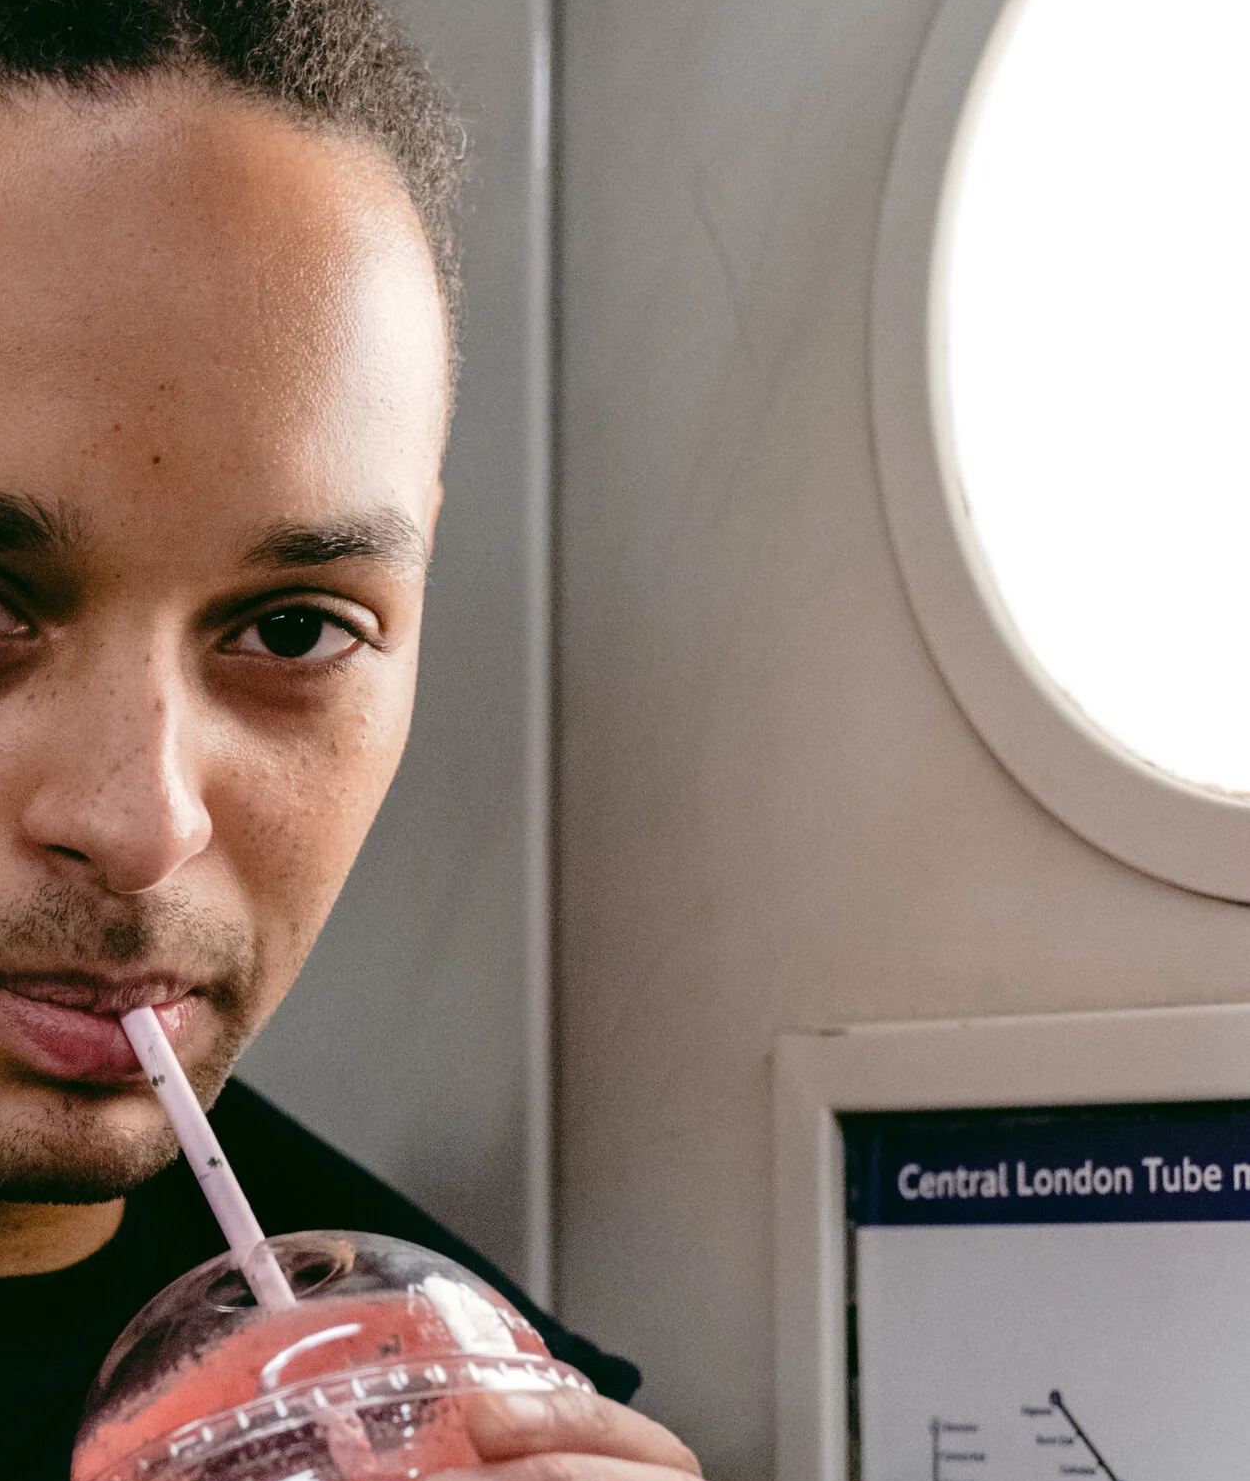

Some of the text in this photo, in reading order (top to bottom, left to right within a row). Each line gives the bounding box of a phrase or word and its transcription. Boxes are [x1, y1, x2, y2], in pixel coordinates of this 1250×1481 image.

[898, 1162, 1009, 1201] Central
[1016, 1159, 1134, 1198] London
[1142, 1155, 1223, 1194] Tube
